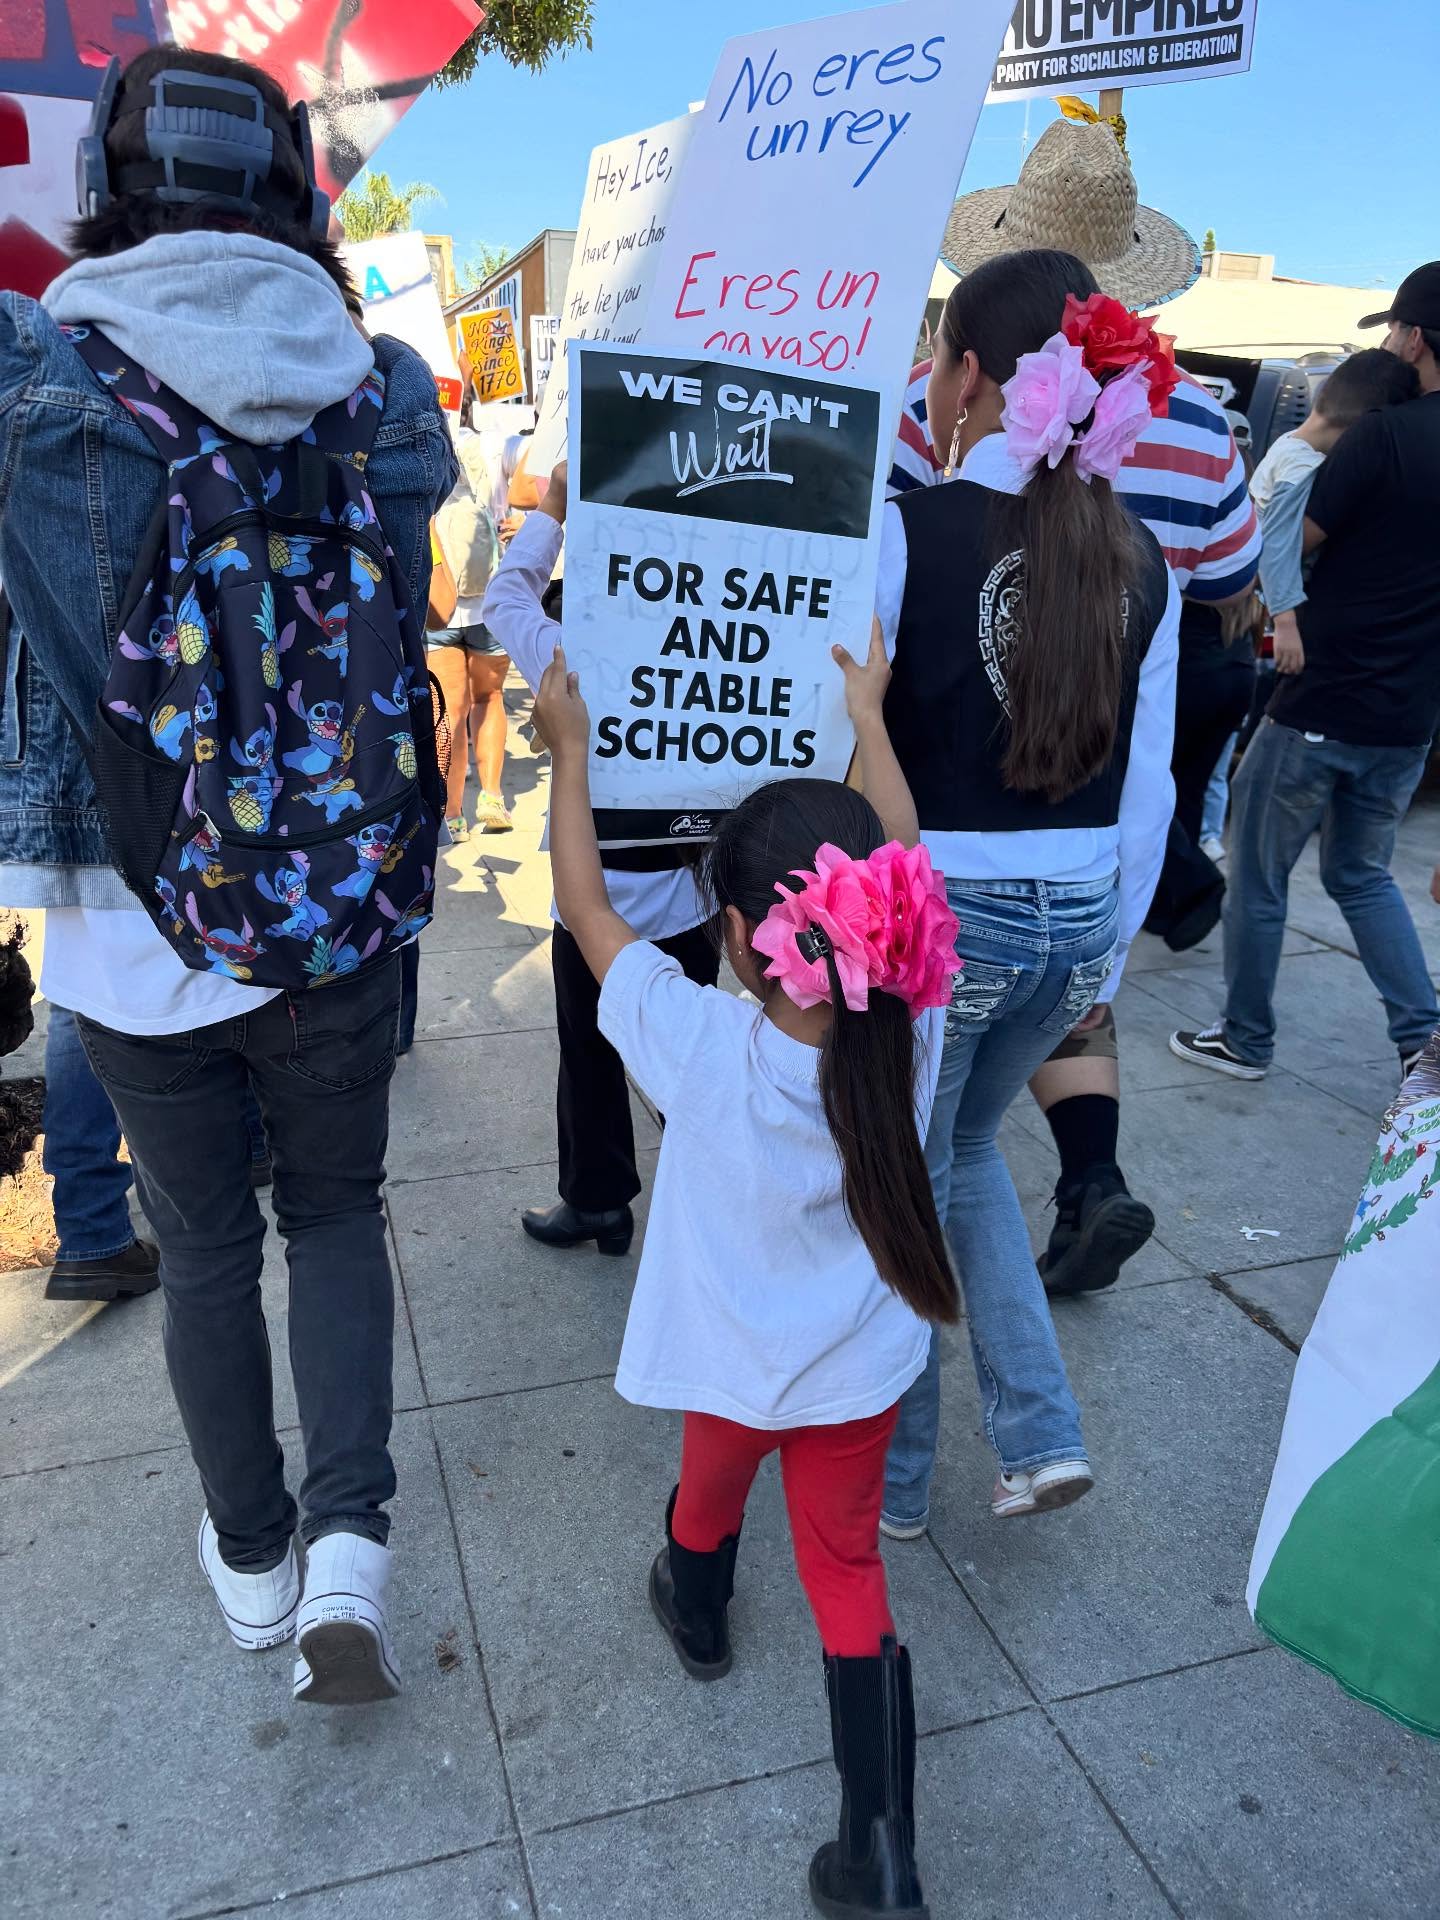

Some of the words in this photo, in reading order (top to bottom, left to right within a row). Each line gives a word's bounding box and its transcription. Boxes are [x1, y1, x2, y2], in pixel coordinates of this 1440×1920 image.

[718, 48, 792, 122] No
[812, 36, 945, 97] eres
[997, 60, 1040, 83] PARTY
[1042, 57, 1068, 77] FOR
[1071, 47, 1145, 73] SOCIALISM
[1148, 46, 1159, 65] &
[1162, 34, 1237, 64] LIBERATION
[746, 119, 809, 161] un
[593, 154, 629, 203] Hey
[630, 138, 673, 191] Ice,
[581, 227, 611, 266] have
[613, 231, 637, 265] you
[571, 290, 589, 321] the
[594, 284, 612, 315] lie
[612, 284, 641, 324] you
[675, 251, 801, 319] Eres
[816, 269, 880, 309] un
[468, 313, 501, 337] No
[469, 334, 514, 355] Kings
[480, 367, 517, 395] 1776
[619, 371, 702, 406] WE
[717, 384, 849, 428] CAN'T
[669, 407, 786, 484] Wait
[607, 553, 704, 606] FOR
[720, 567, 833, 619] SAFE
[660, 616, 770, 664] AND
[629, 665, 793, 718] STABLE
[595, 716, 817, 769] SCHOOLS
